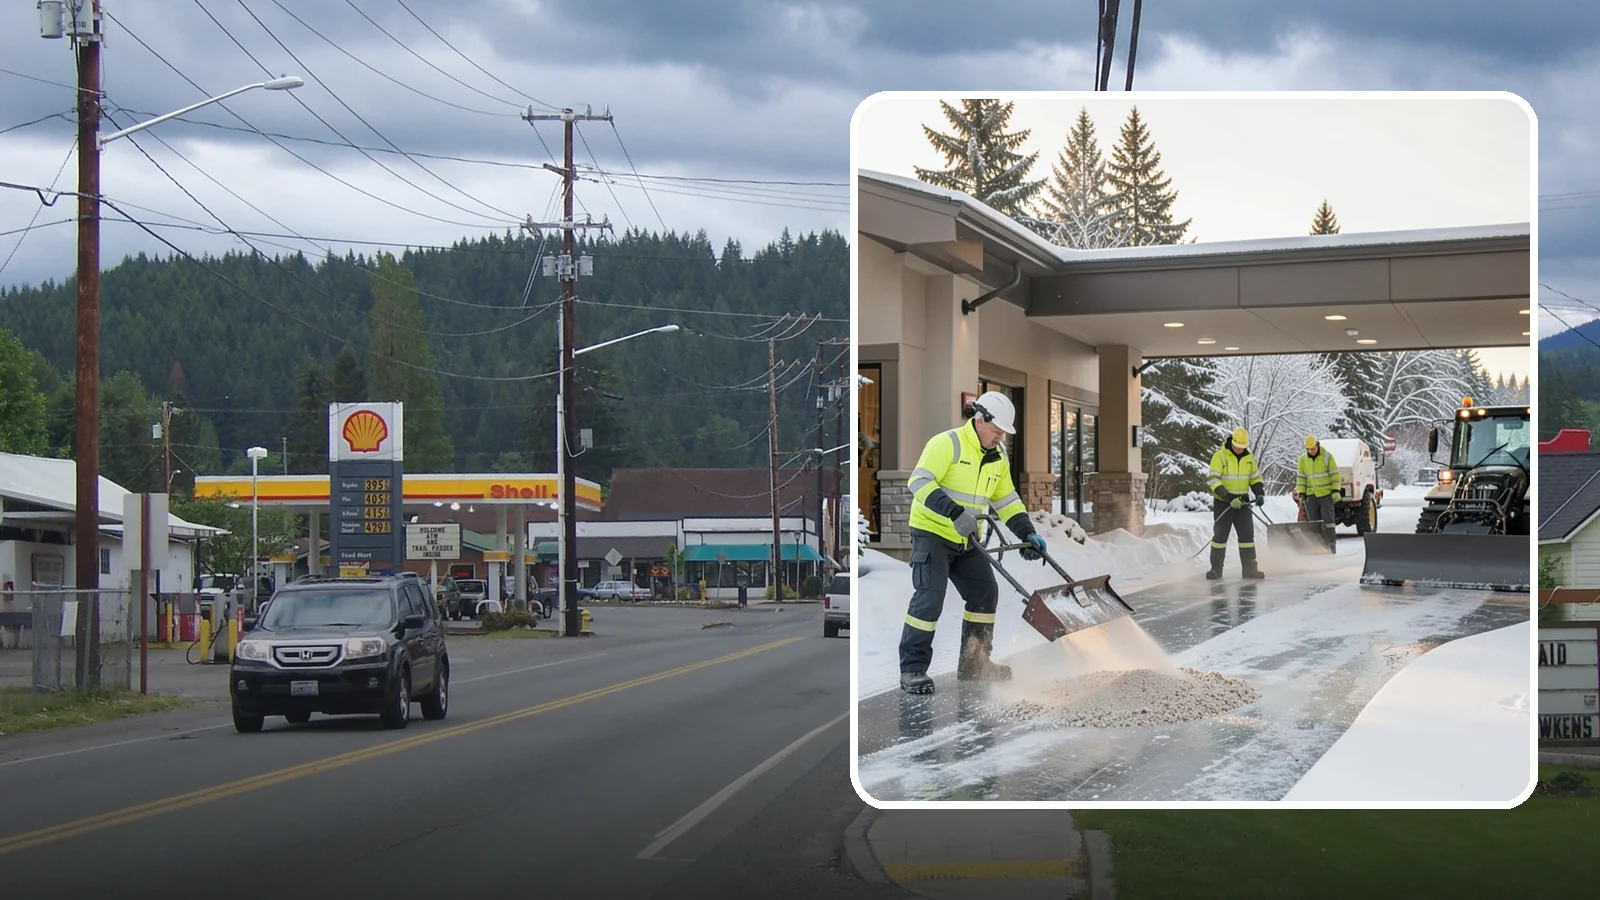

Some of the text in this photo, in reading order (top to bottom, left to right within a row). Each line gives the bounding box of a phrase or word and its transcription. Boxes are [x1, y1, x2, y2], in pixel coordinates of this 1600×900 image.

[365, 480, 383, 490] 395
[490, 484, 547, 499] Shell
[365, 494, 383, 504] 405
[365, 508, 383, 518] 415
[365, 522, 383, 532] 429
[1538, 643, 1566, 665] AID
